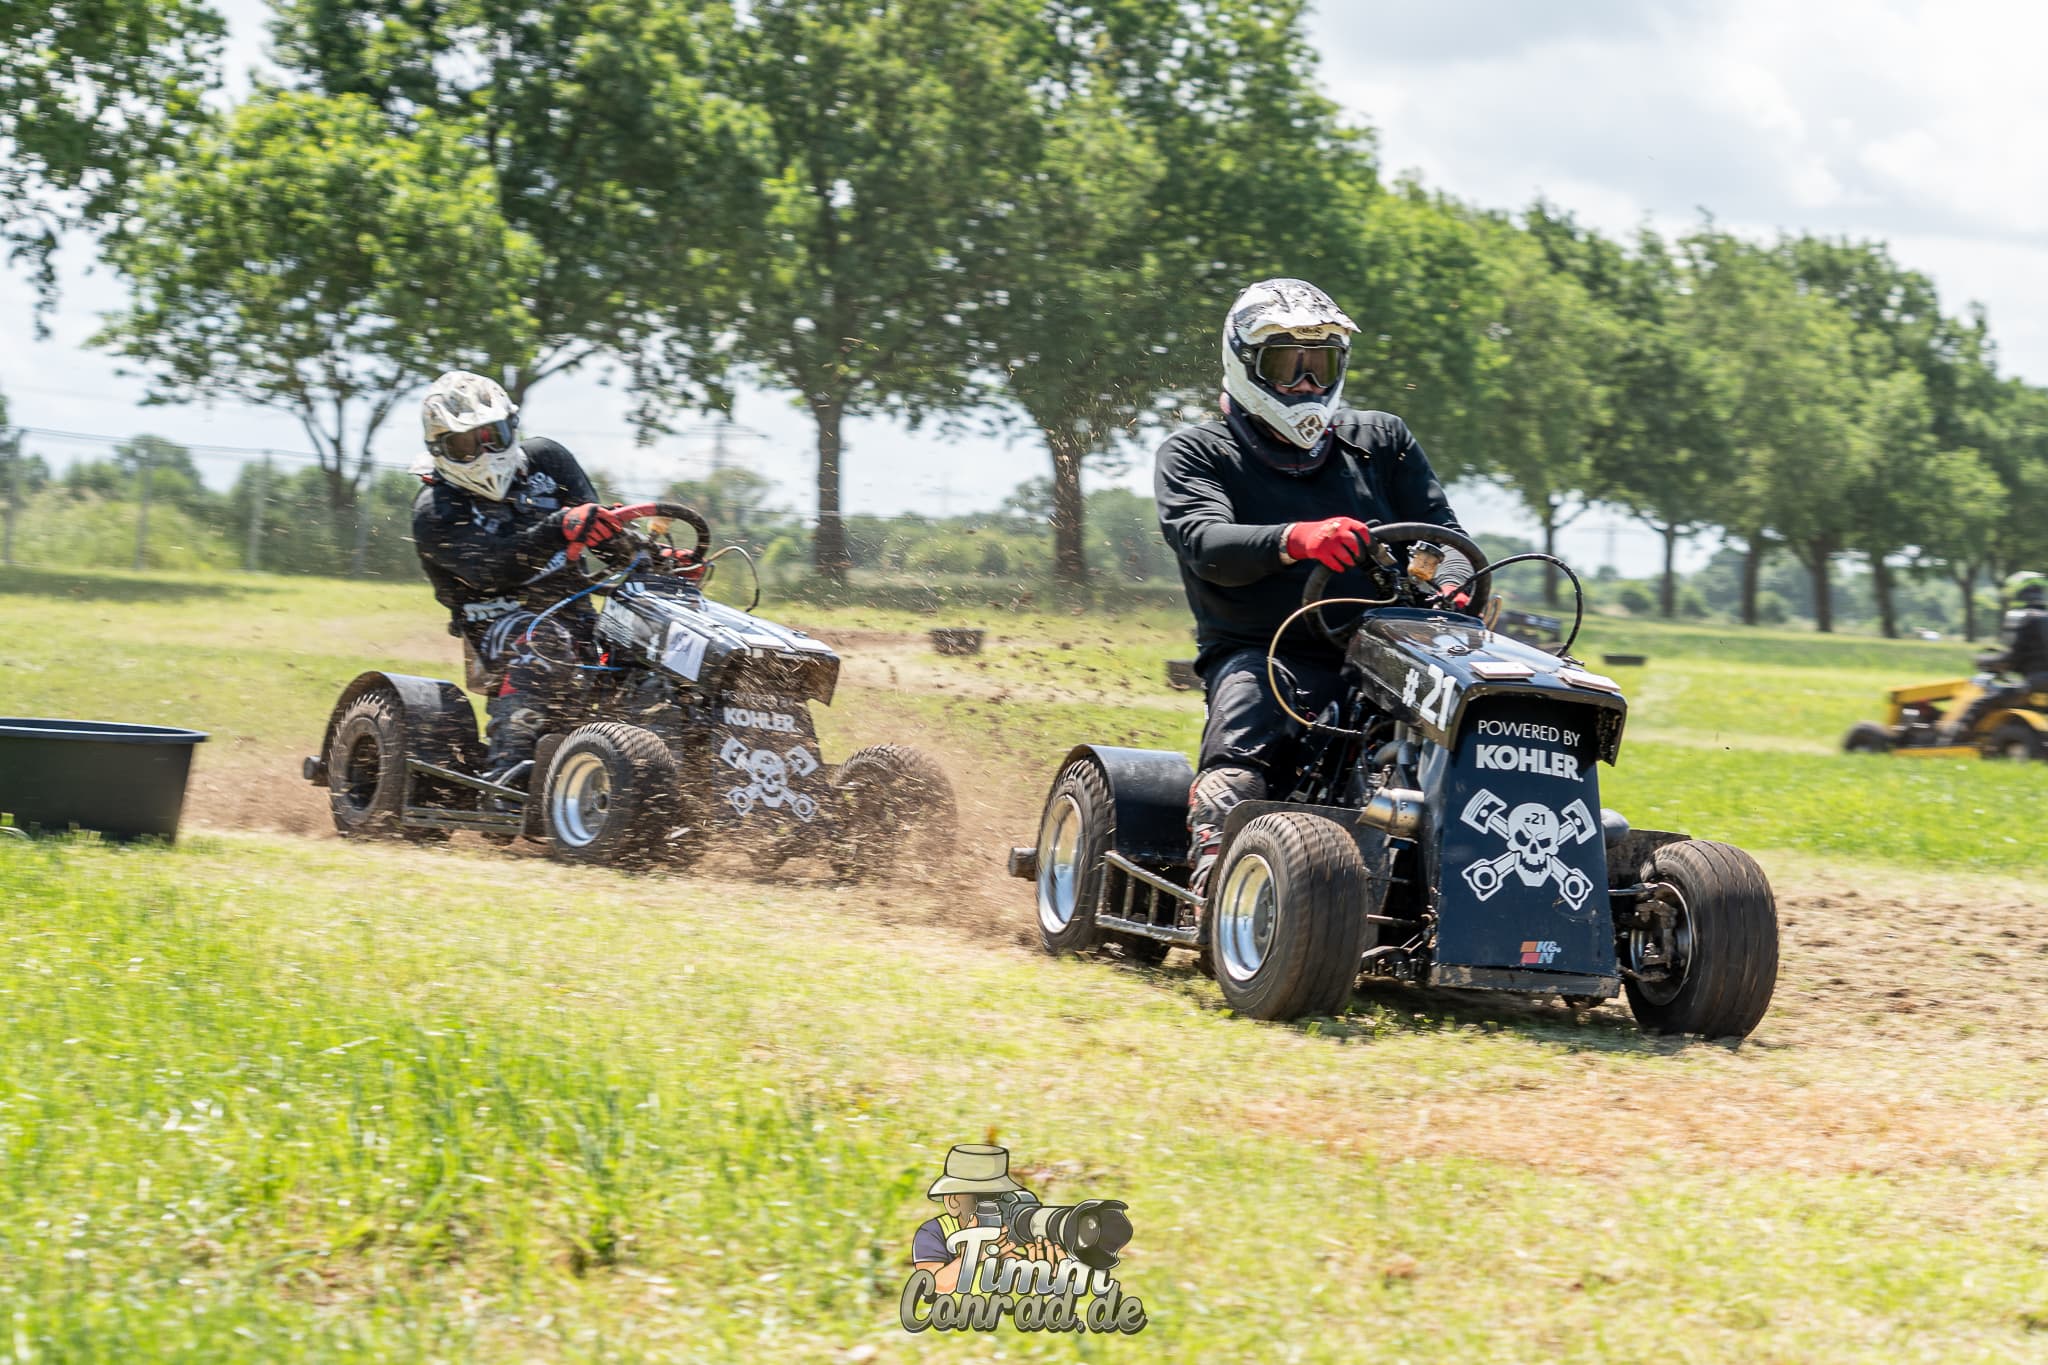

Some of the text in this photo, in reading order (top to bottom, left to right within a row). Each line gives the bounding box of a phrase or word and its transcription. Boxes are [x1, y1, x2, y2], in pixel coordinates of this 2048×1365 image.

[723, 707, 797, 732] KOHLER
[1478, 720, 1581, 747] POWERED BY
